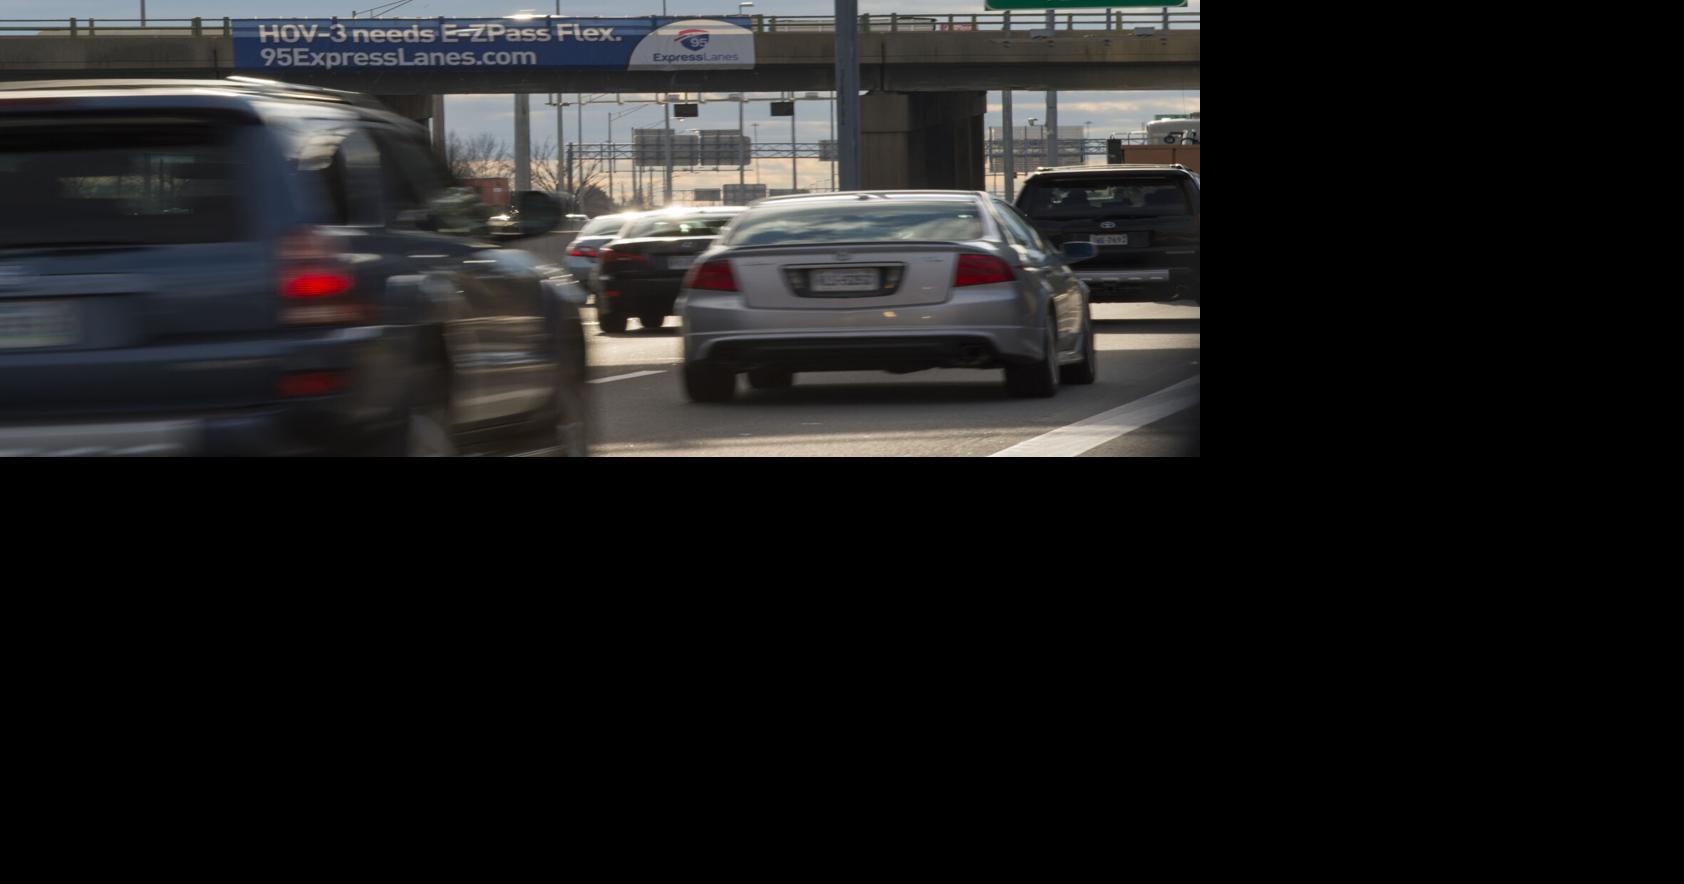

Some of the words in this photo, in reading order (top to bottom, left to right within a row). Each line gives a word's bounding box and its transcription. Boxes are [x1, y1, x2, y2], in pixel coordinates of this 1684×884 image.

[258, 23, 347, 43] HOV-3
[352, 24, 436, 43] needs
[440, 23, 550, 42] E-ZPass
[556, 23, 622, 42] Flex.
[689, 38, 706, 48] 95
[260, 47, 537, 69] 95ExpressLanes.com
[653, 52, 738, 63] ExpressLanes
